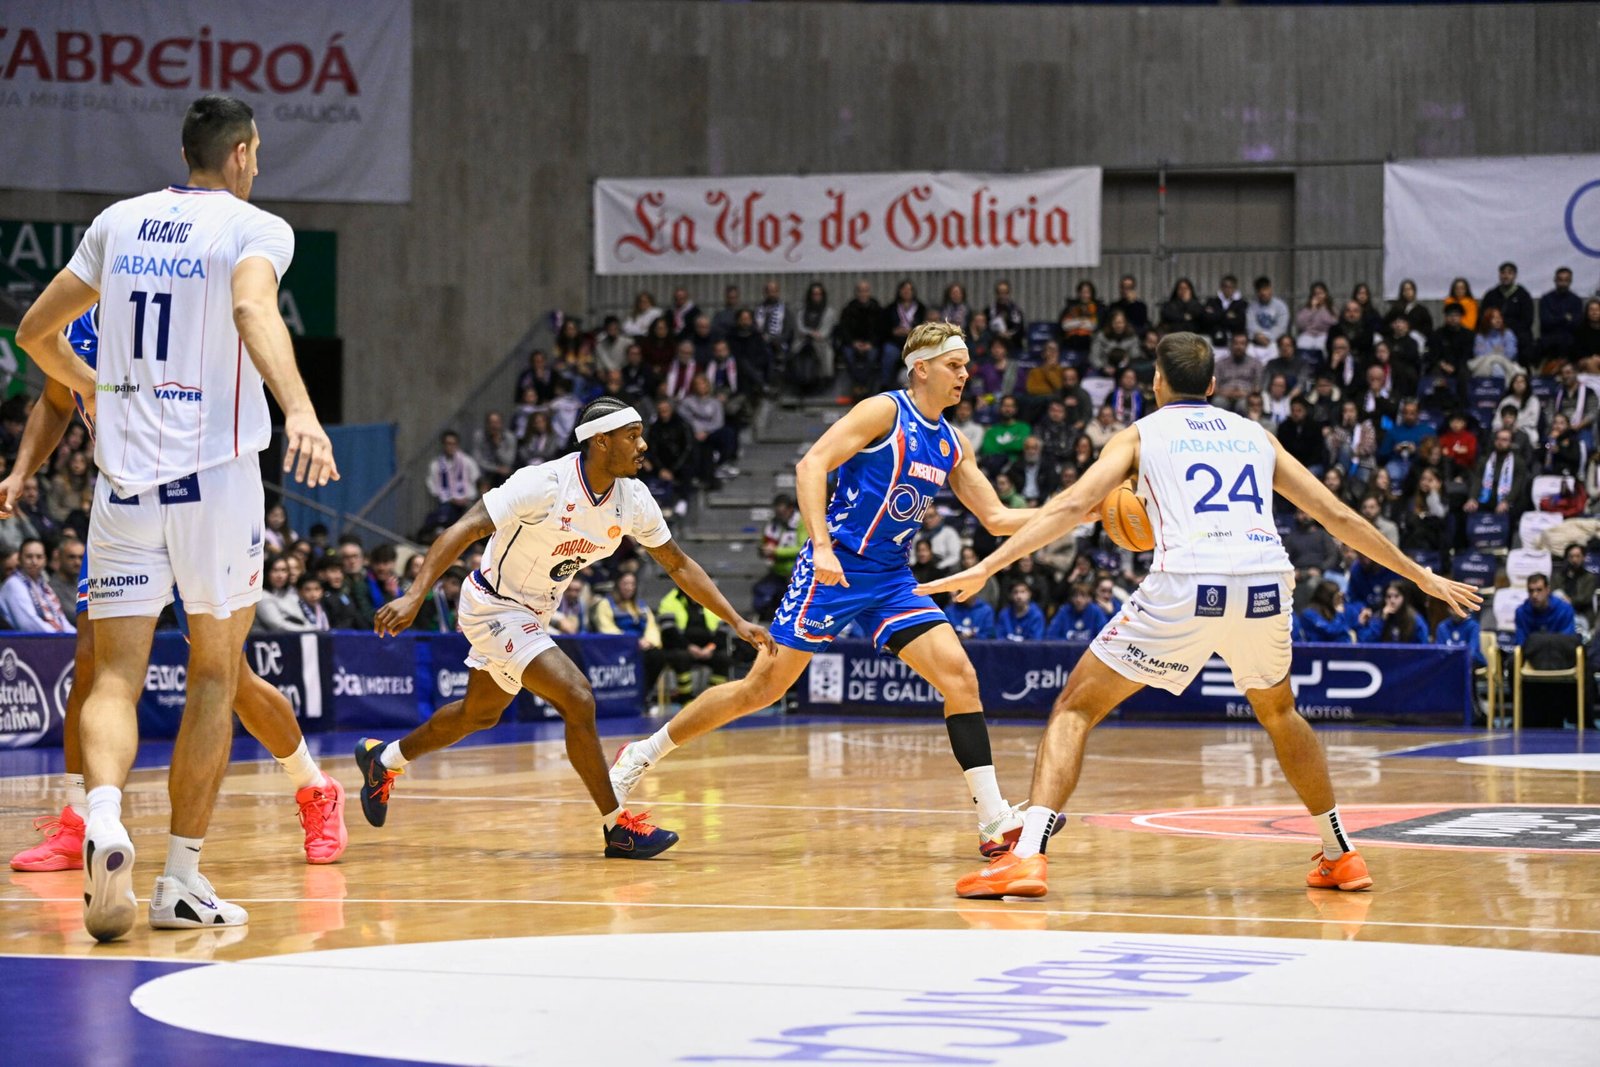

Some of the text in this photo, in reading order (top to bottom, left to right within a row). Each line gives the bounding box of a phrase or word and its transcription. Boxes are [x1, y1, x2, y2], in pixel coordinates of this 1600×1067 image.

[614, 186, 1074, 262] La Voz de Galicia
[128, 290, 172, 361] 11
[153, 388, 203, 401] VAYPER
[1185, 417, 1227, 431] BRITO
[1185, 462, 1264, 515] 24
[100, 574, 149, 588] MADRID
[1126, 643, 1189, 672] HEY, MADRID
[848, 681, 878, 701] DE
[1226, 702, 1253, 718] RES
